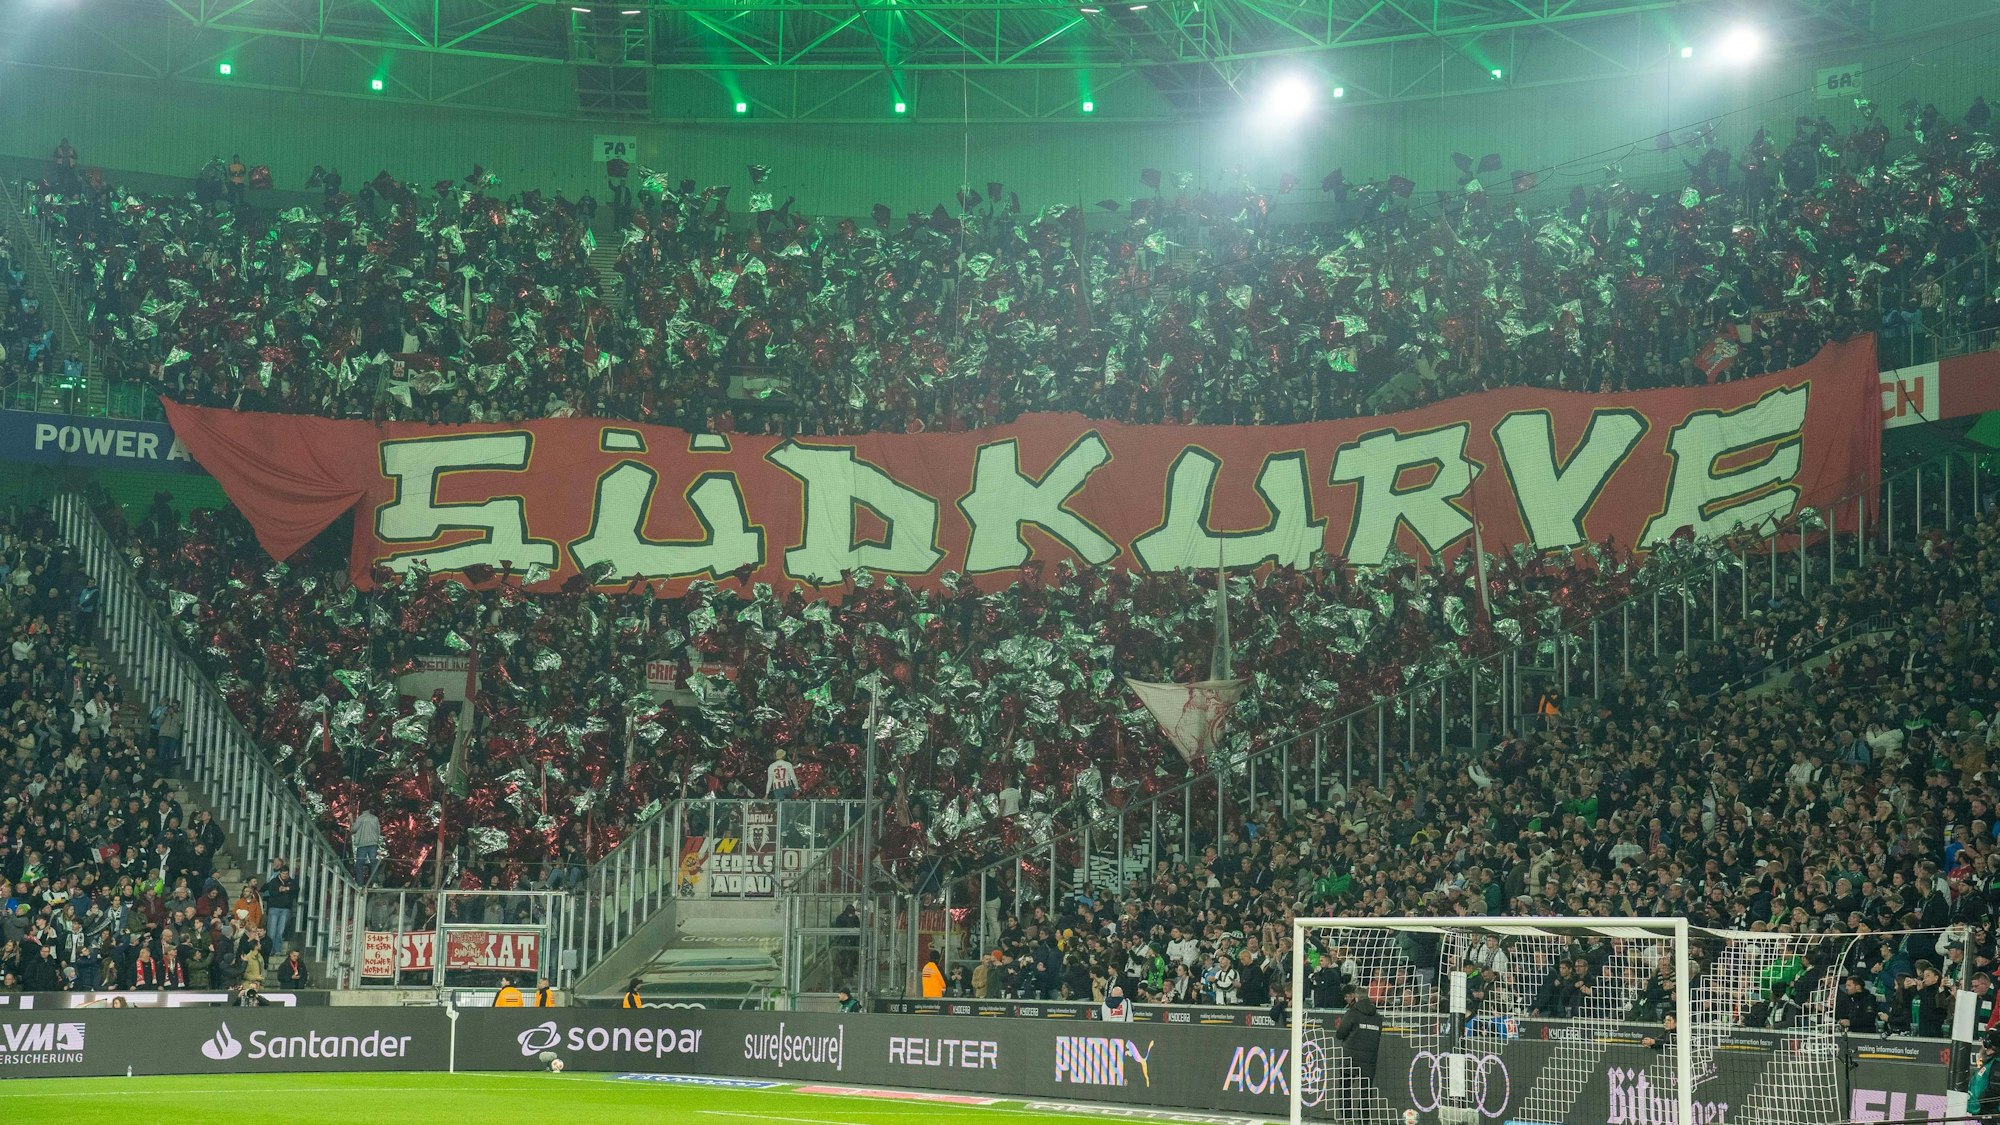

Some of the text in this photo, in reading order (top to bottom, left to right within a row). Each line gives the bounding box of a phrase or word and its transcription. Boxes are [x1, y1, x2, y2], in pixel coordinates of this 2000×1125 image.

[1827, 72, 1852, 90] 6A
[603, 141, 626, 156] 7A
[35, 423, 158, 460] POWER
[375, 381, 1813, 588] SÜDKURVE
[774, 768, 786, 780] 37
[712, 854, 774, 873] EEDELS
[711, 875, 772, 893] ADAU
[375, 951, 381, 959] 6
[1168, 1013, 1190, 1022] KYOCERA
[248, 1030, 412, 1059] Santander
[567, 1027, 702, 1058] sonepar
[744, 1022, 844, 1071] sure[secure]
[889, 1036, 998, 1070] REUTER
[1857, 1045, 1919, 1055] making information faster
[1055, 1036, 1124, 1086] PUMA
[1222, 1046, 1290, 1096] AOK
